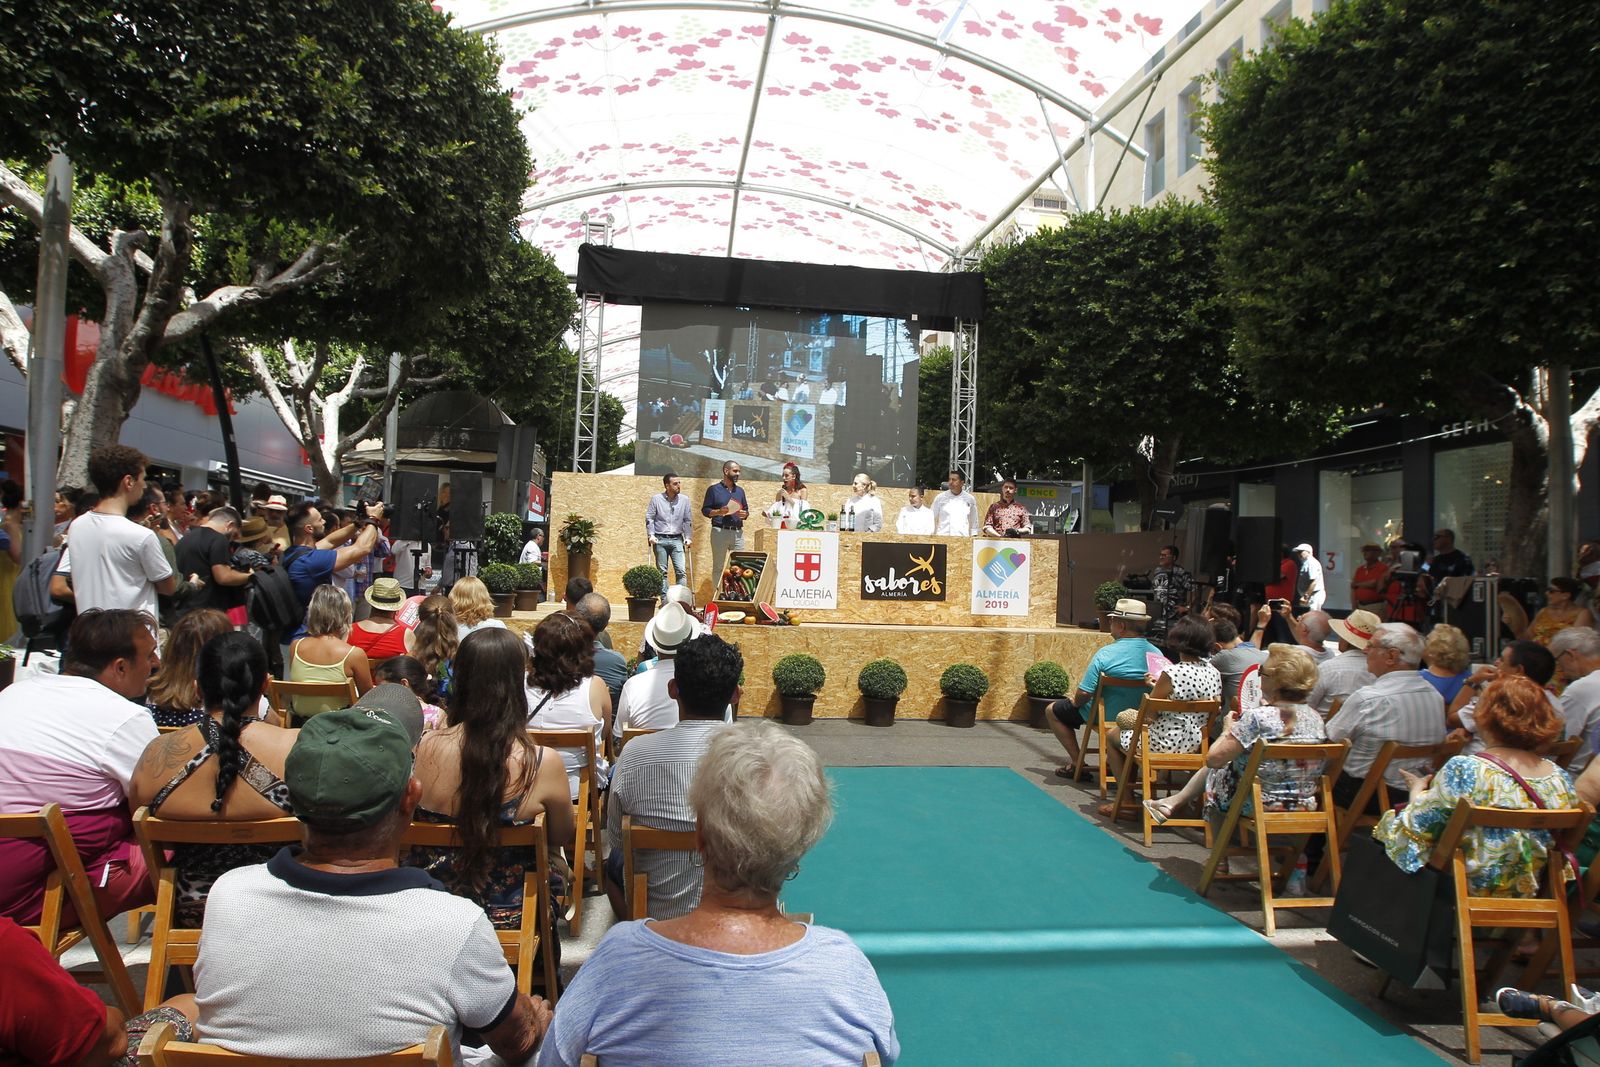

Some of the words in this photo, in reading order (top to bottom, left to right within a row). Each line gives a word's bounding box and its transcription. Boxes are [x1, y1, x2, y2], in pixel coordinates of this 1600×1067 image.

[1441, 418, 1499, 439] SEPH
[1030, 488, 1055, 498] ONCE
[1326, 551, 1335, 571] 3
[864, 567, 944, 596] sabores
[780, 587, 833, 600] ALMERÍA
[975, 588, 1020, 600] ALMERÍA
[792, 599, 820, 607] CIUDAD
[984, 600, 1009, 609] 2019
